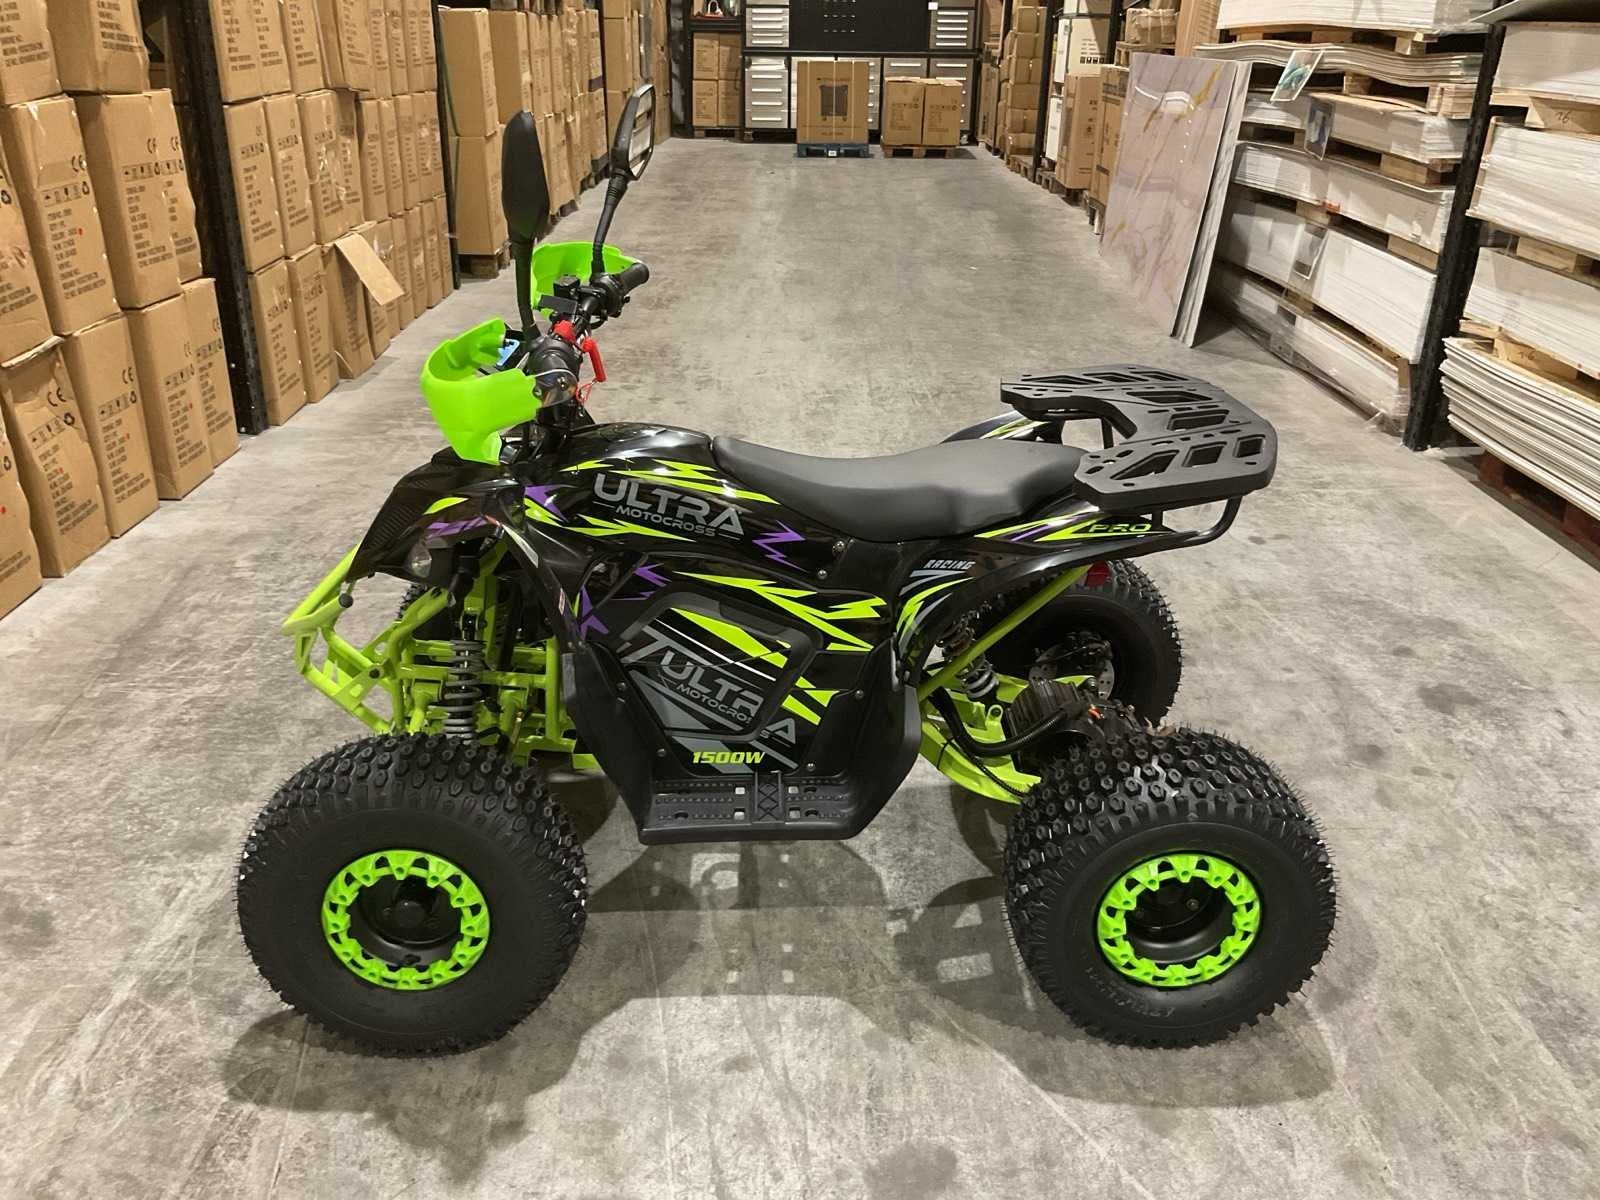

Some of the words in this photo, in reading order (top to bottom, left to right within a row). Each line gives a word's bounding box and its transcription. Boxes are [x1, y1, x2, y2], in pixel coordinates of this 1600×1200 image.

[594, 473, 744, 535] ULTRA
[615, 505, 716, 537] MOTOCROSS
[1088, 523, 1152, 533] PRO
[923, 559, 976, 570] RACING
[692, 751, 766, 764] 1500W
